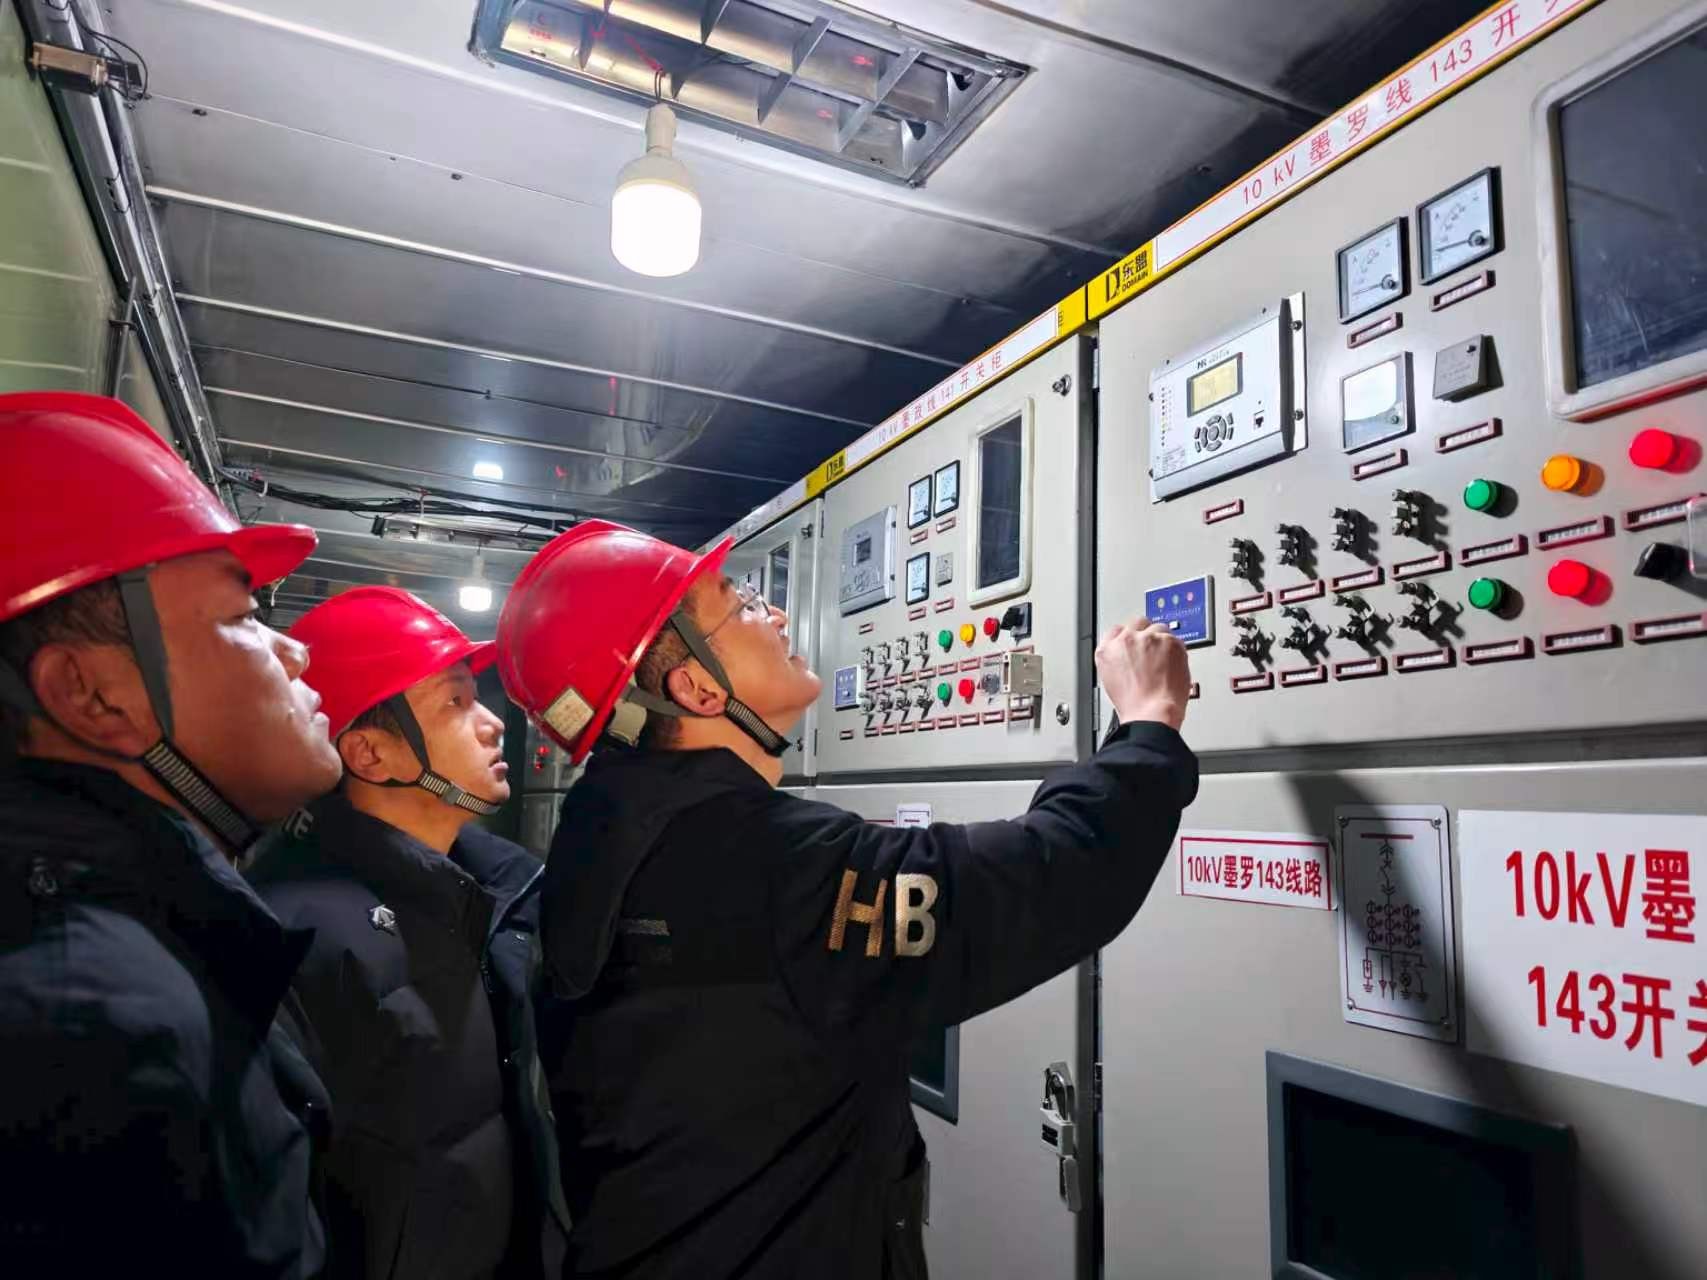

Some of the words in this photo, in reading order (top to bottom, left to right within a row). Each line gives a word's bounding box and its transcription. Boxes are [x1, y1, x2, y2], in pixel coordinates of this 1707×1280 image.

[1243, 178, 1263, 205] 10
[1274, 154, 1296, 186] kV
[1430, 39, 1473, 82] 143
[828, 868, 938, 957] HB
[1187, 855, 1322, 898] 10kV墨罗143线路
[1506, 848, 1696, 943] 10kV墨
